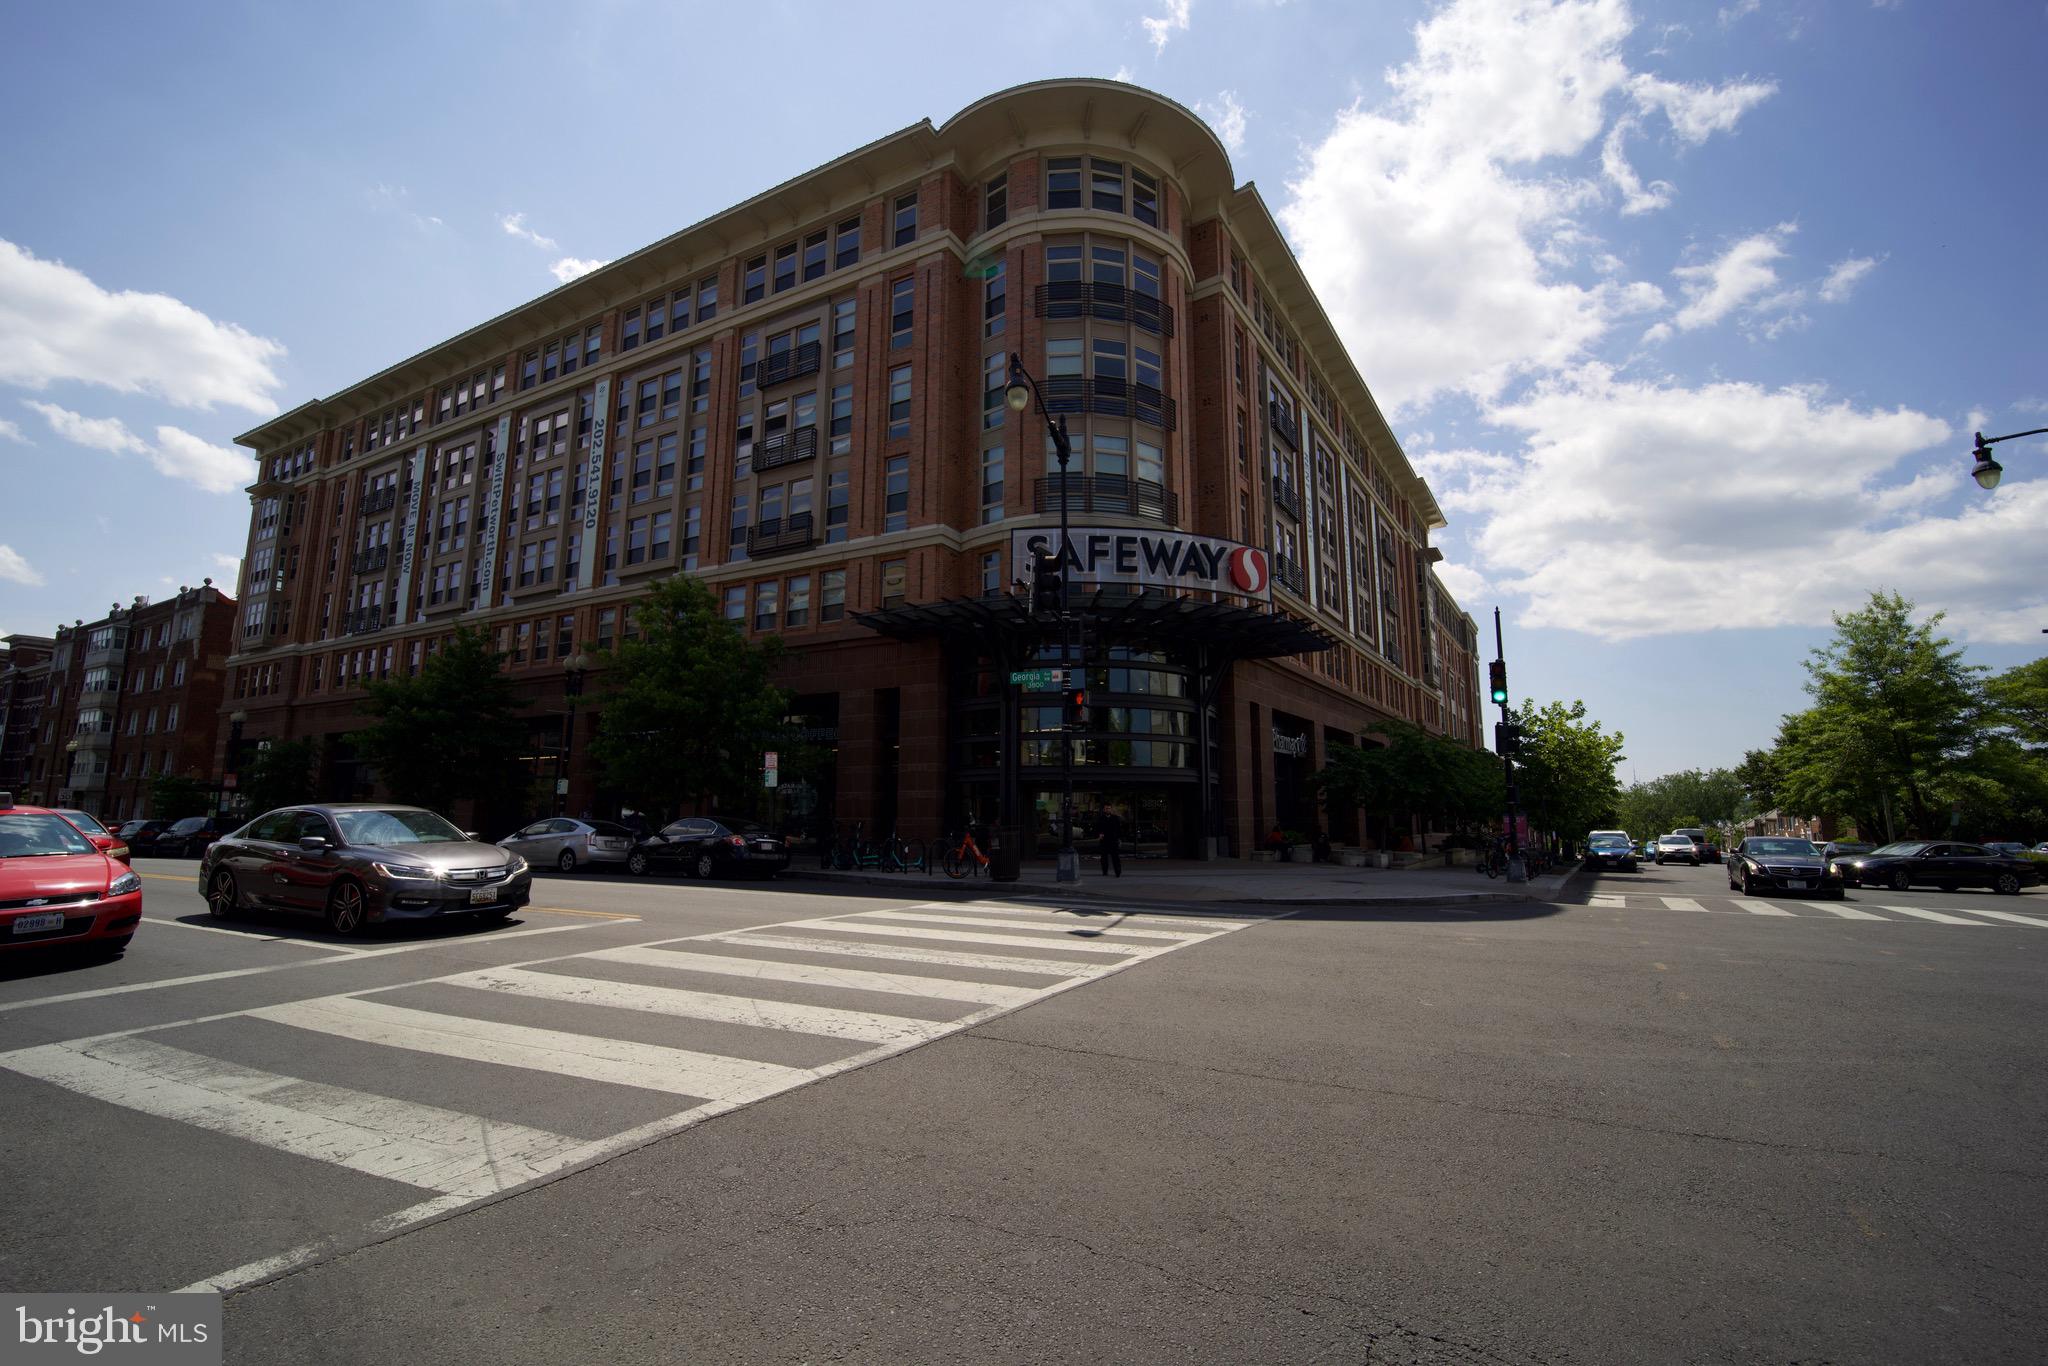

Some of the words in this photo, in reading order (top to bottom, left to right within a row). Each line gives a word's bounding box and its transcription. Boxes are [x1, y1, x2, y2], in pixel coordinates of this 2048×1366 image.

[586, 419, 605, 529] 202.541.9120
[410, 481, 421, 519] MOVE
[408, 524, 416, 537] IN
[403, 543, 413, 574] NOW
[1012, 672, 1040, 682] Georgia
